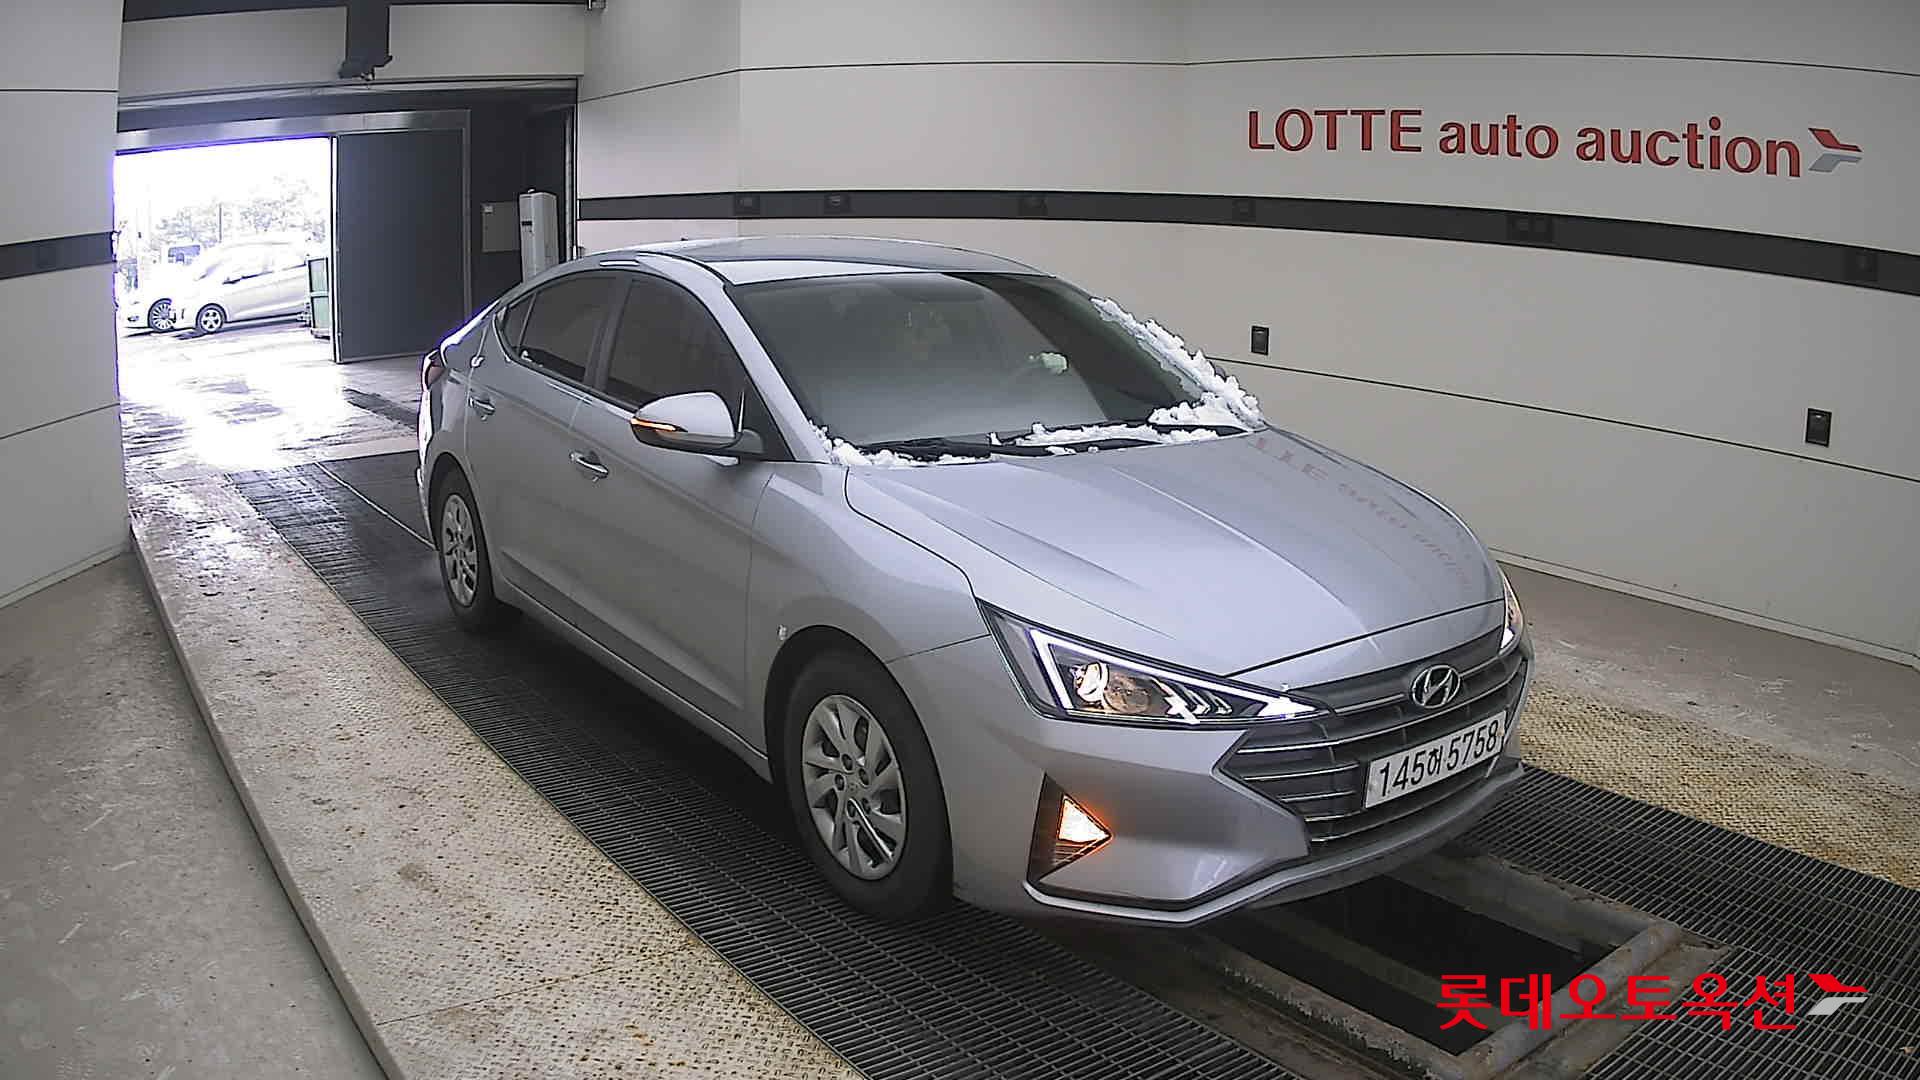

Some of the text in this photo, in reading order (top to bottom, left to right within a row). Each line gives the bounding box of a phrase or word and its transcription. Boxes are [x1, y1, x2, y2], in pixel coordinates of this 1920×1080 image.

[1248, 109, 1801, 177] LOTTE auto auction
